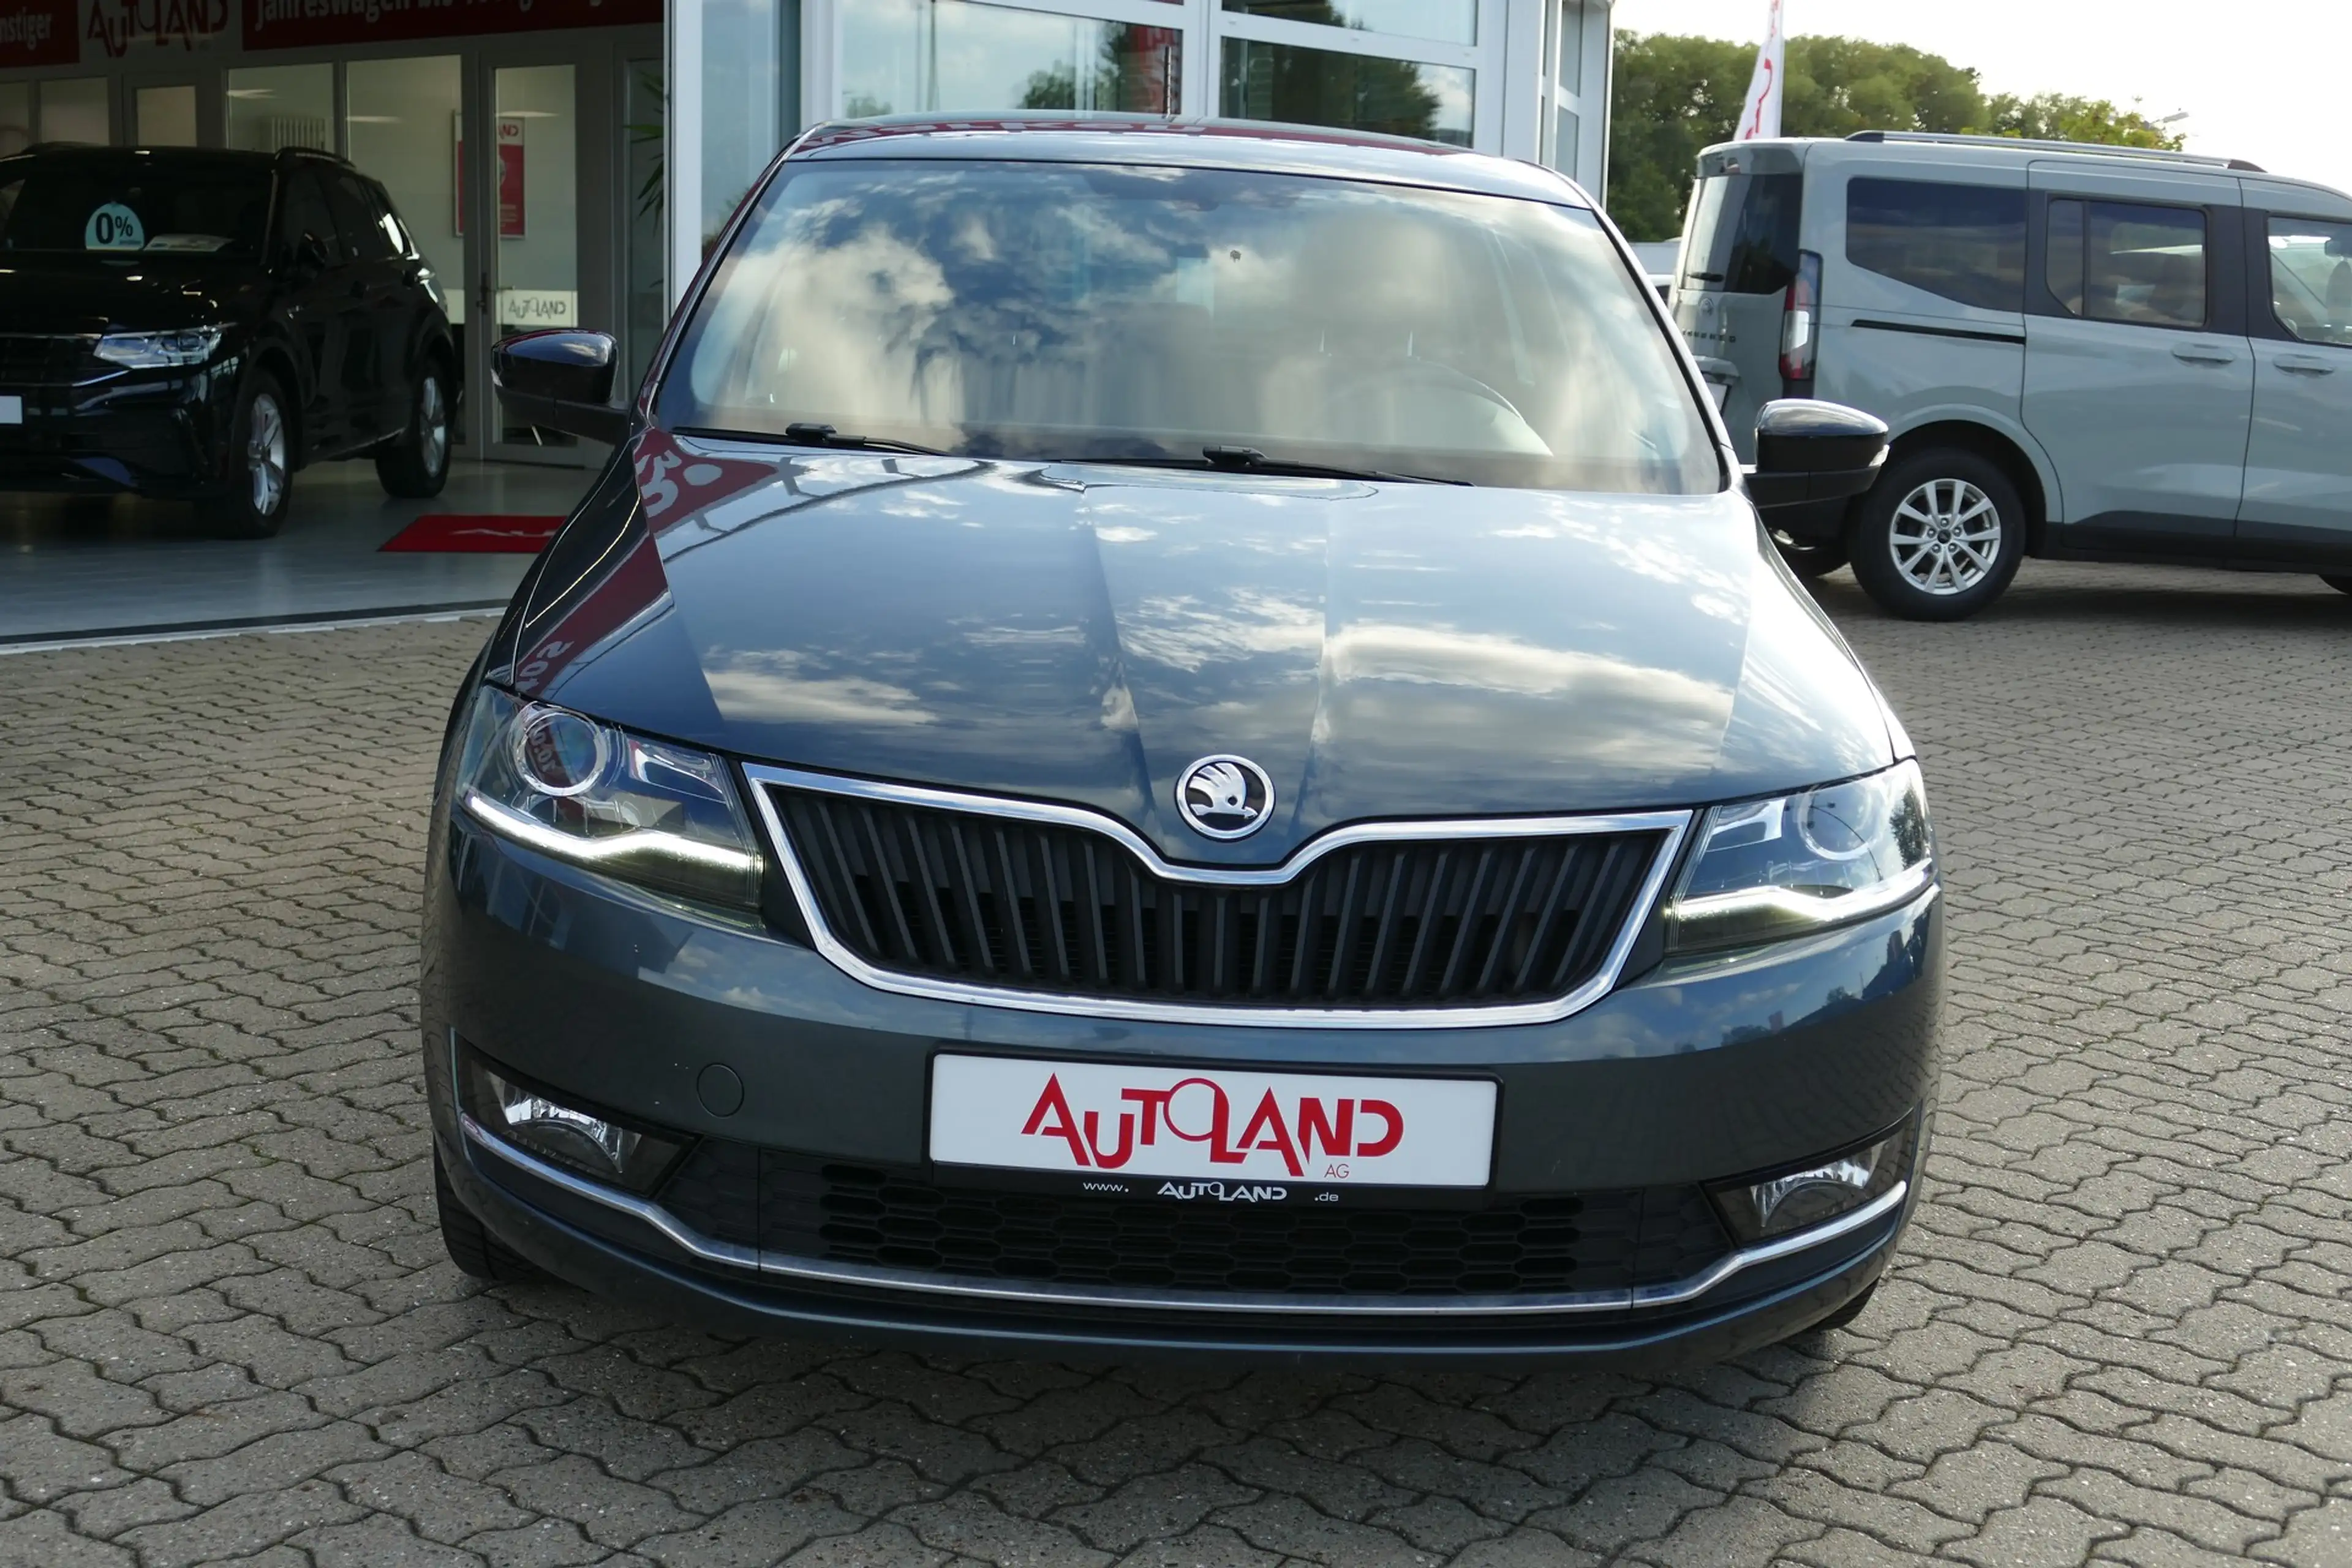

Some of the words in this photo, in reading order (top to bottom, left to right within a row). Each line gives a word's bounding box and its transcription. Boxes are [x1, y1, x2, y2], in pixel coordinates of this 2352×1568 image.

[96, 213, 133, 244] 0%
[1021, 1072, 1404, 1177] AUTOLAND
[1324, 1164, 1350, 1178] AG
[1083, 1182, 1129, 1193] www.
[1157, 1182, 1287, 1202] AUTOLAND
[1314, 1192, 1339, 1202] .de
